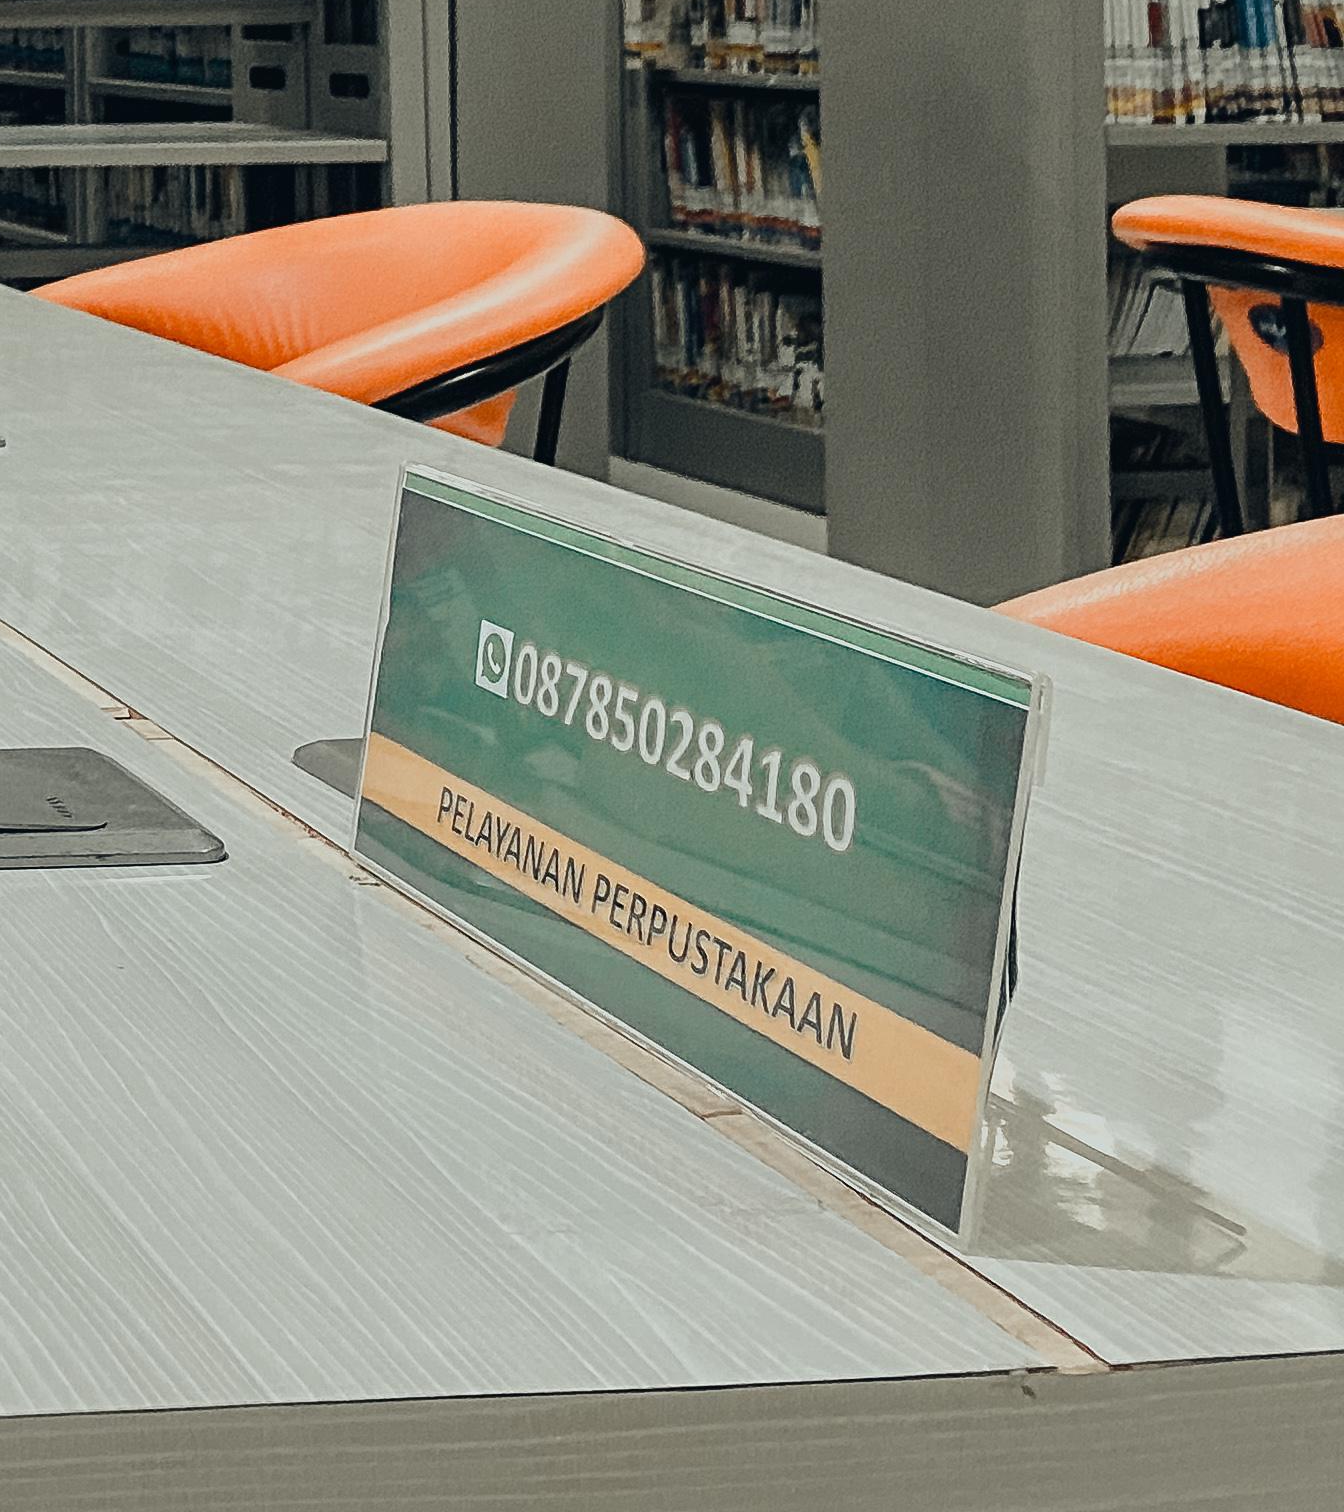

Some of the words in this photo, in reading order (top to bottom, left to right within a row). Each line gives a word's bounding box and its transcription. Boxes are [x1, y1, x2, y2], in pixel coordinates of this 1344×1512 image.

[513, 643, 857, 853] 087850284180
[437, 785, 587, 906] PELAYANAN
[591, 873, 858, 1061] PERPUSTAKAAN
